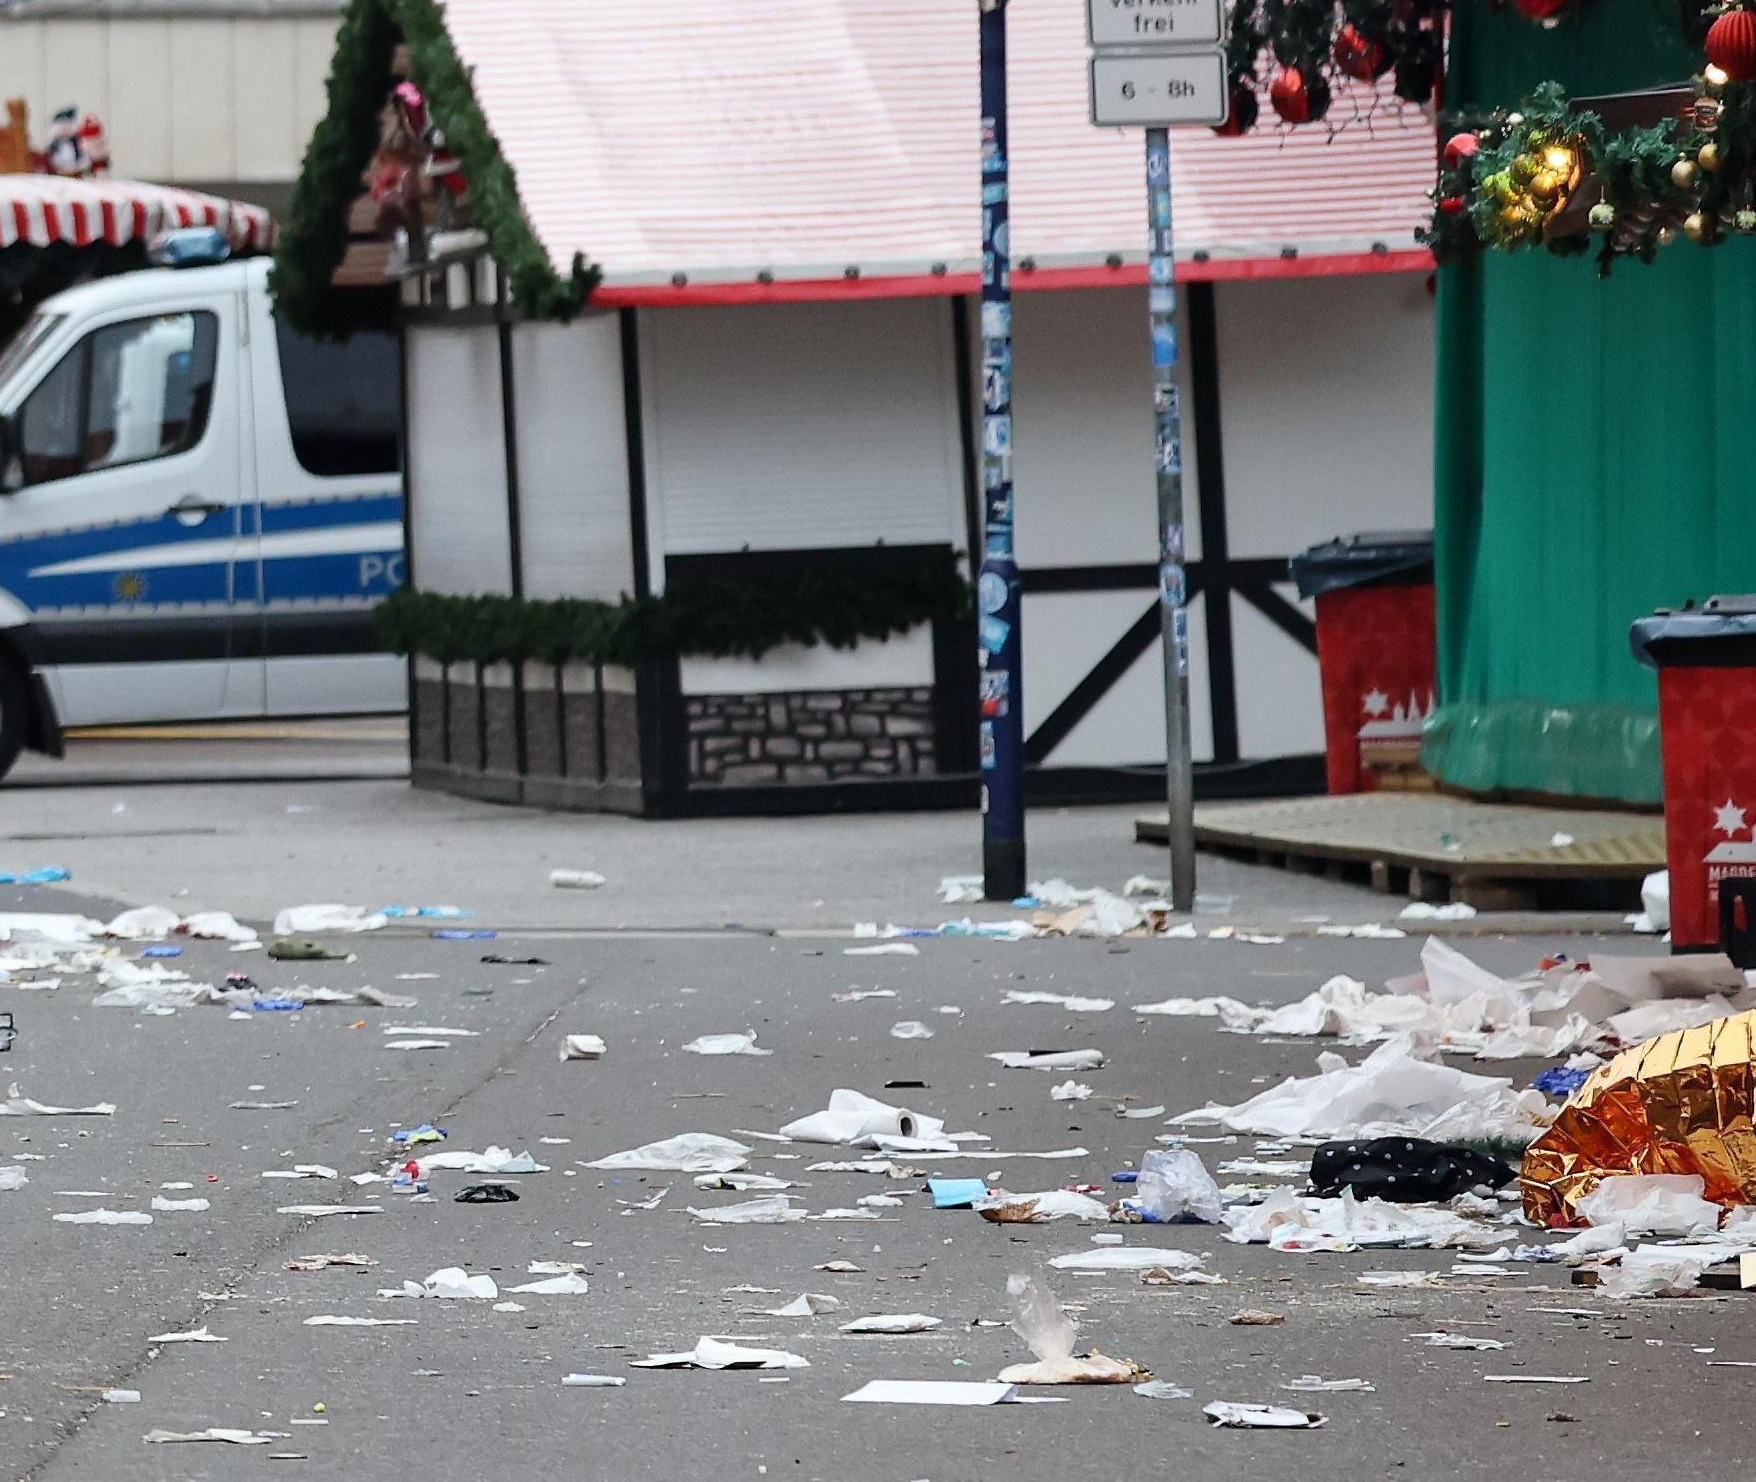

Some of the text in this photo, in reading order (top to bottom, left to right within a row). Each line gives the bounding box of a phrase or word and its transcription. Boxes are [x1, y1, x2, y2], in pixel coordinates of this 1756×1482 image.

[1134, 13, 1174, 33] frei
[1121, 82, 1135, 99] 6
[1167, 81, 1195, 98] 8h
